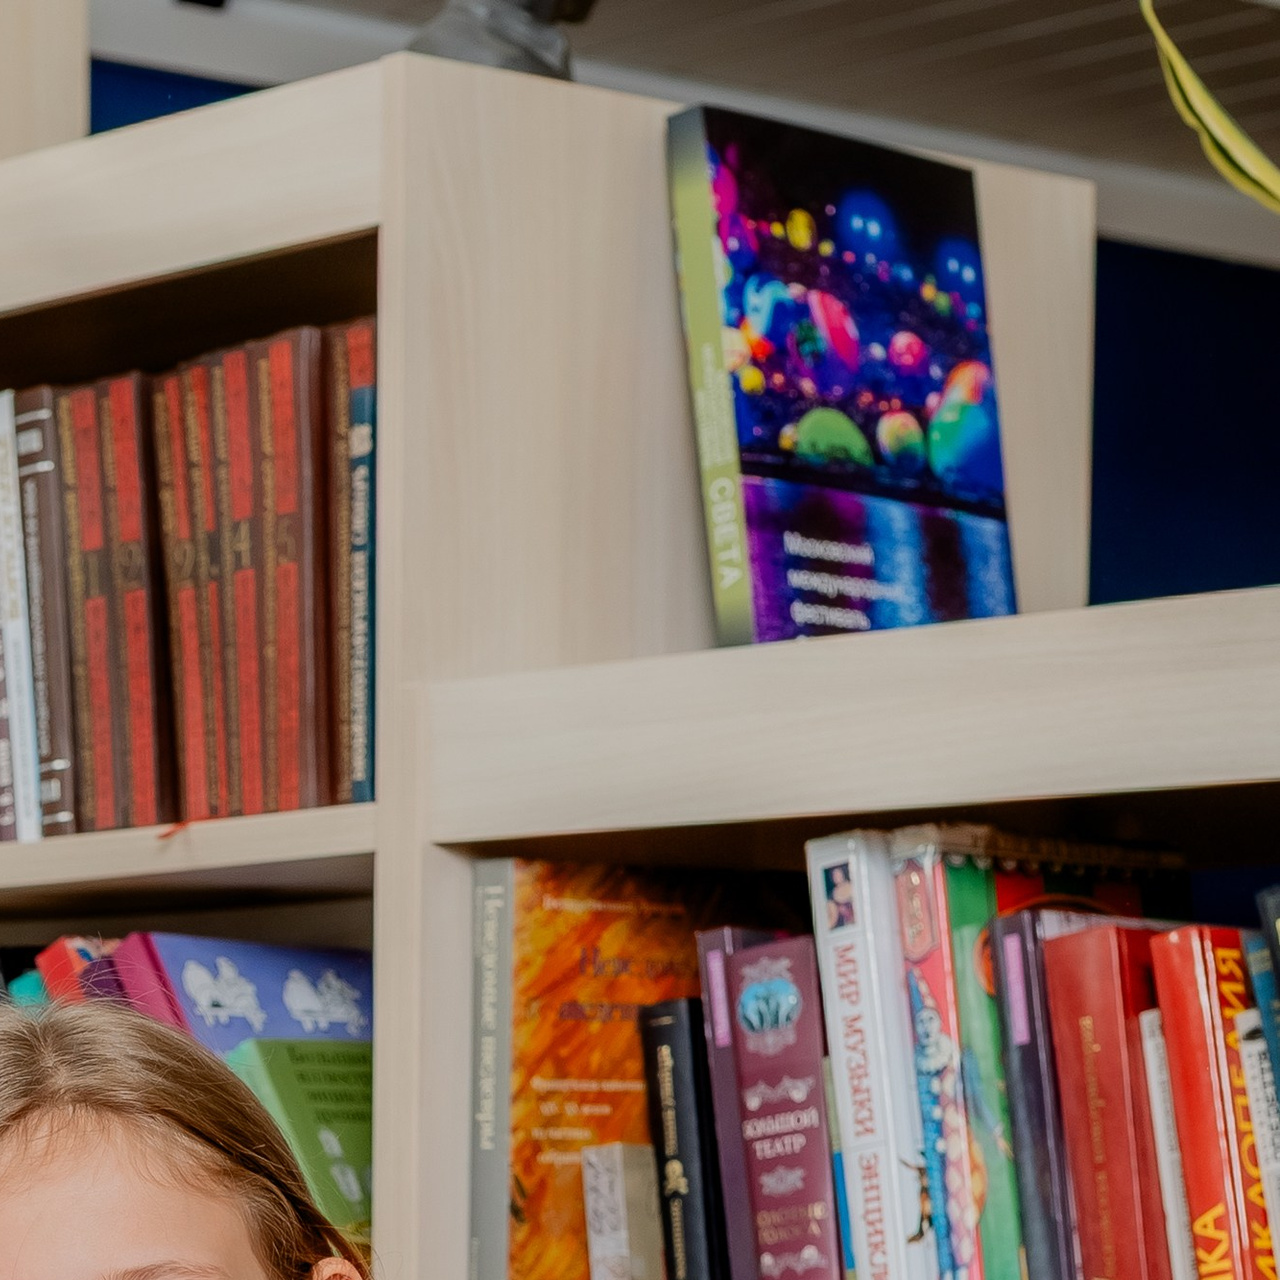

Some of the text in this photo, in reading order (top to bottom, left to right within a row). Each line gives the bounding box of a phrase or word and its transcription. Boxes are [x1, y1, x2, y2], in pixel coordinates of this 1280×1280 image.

[833, 943, 877, 1139] МИР МУЗЫКИ
[752, 1133, 807, 1160] ТЕАТР
